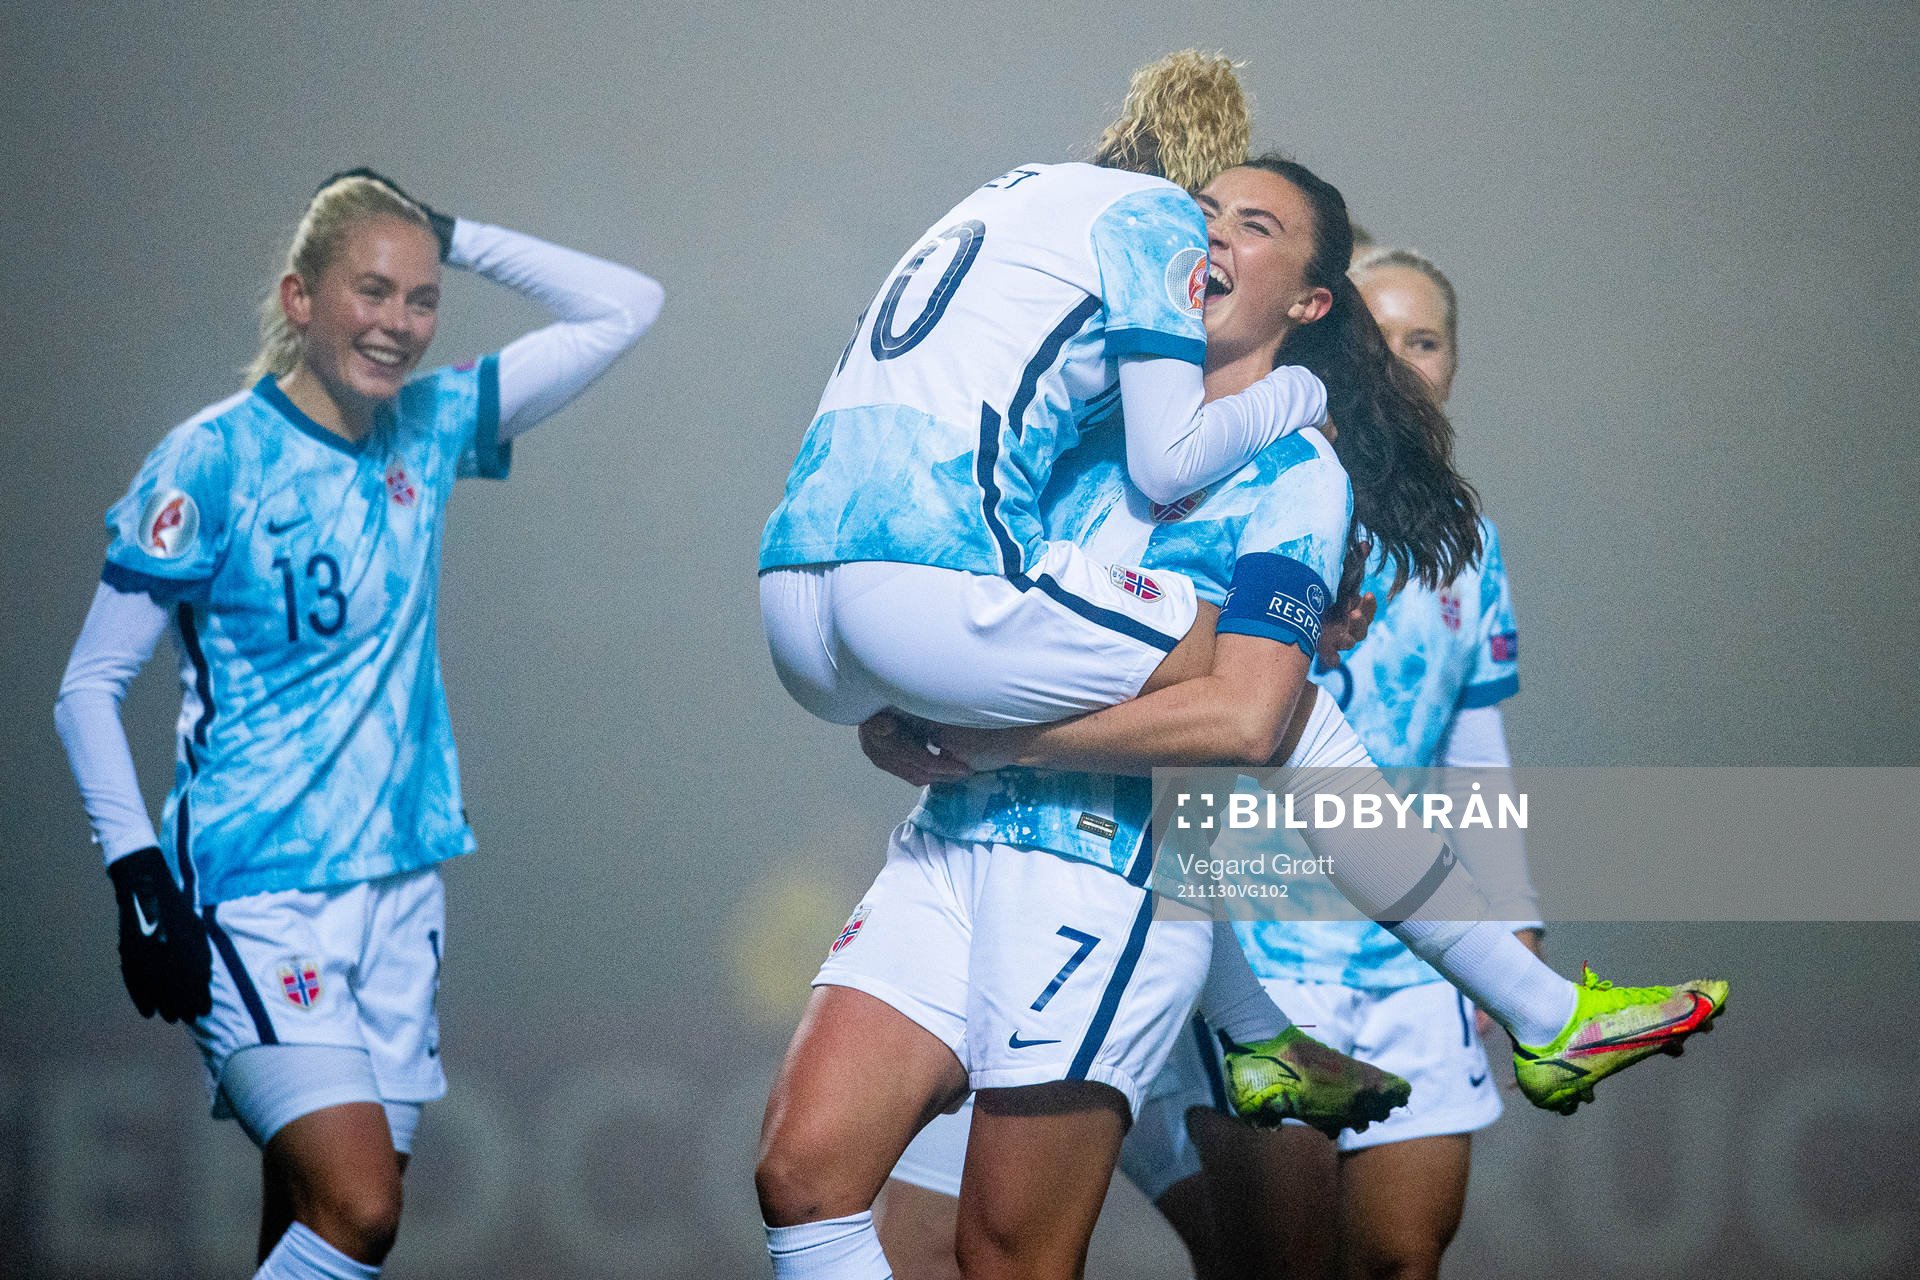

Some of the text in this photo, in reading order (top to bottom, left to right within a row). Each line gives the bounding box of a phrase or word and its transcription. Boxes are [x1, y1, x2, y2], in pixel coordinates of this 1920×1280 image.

[836, 219, 986, 378] 0
[272, 554, 347, 643] 13
[1268, 596, 1321, 648] RESPE
[1029, 924, 1102, 1013] 7
